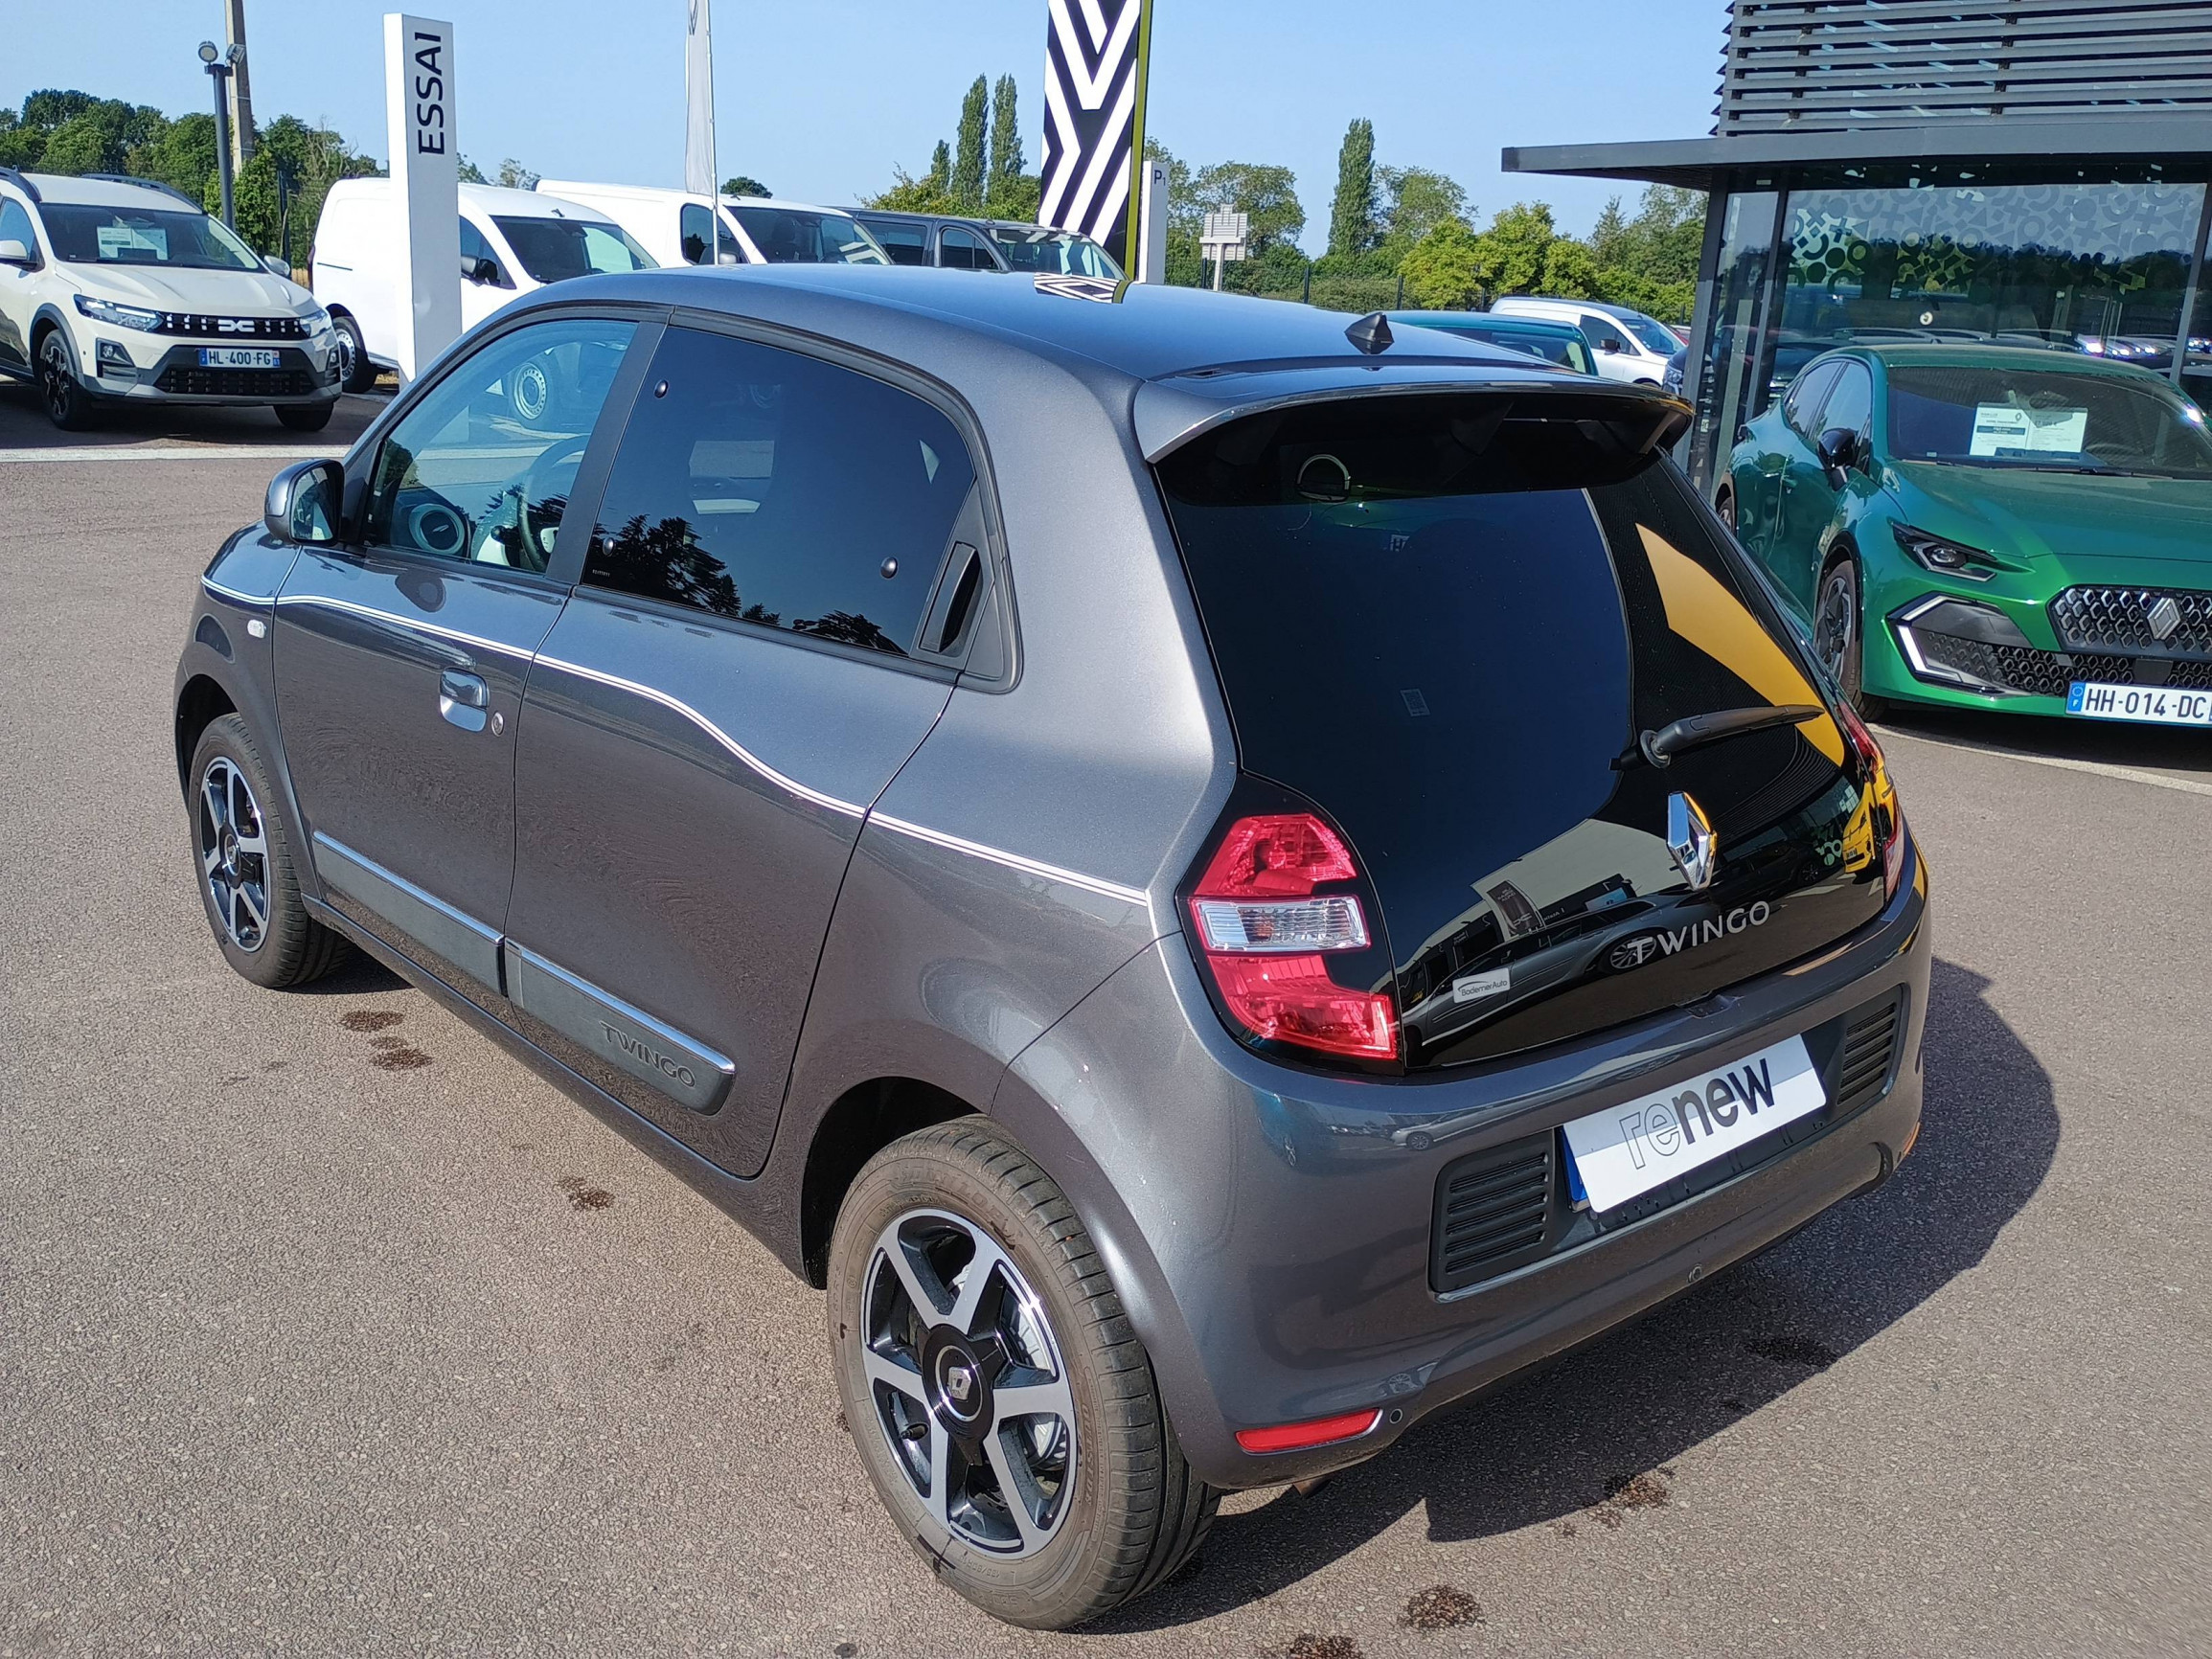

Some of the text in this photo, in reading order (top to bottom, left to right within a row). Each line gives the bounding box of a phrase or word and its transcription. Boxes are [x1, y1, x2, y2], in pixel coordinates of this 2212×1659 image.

[414, 32, 445, 155] ESSAI
[208, 351, 271, 365] HL-400-FG
[2085, 688, 2207, 719] HH-014-DC
[1627, 900, 1770, 965] TWINGO
[599, 1019, 696, 1088] TWINGO
[1618, 1057, 1775, 1170] renew
